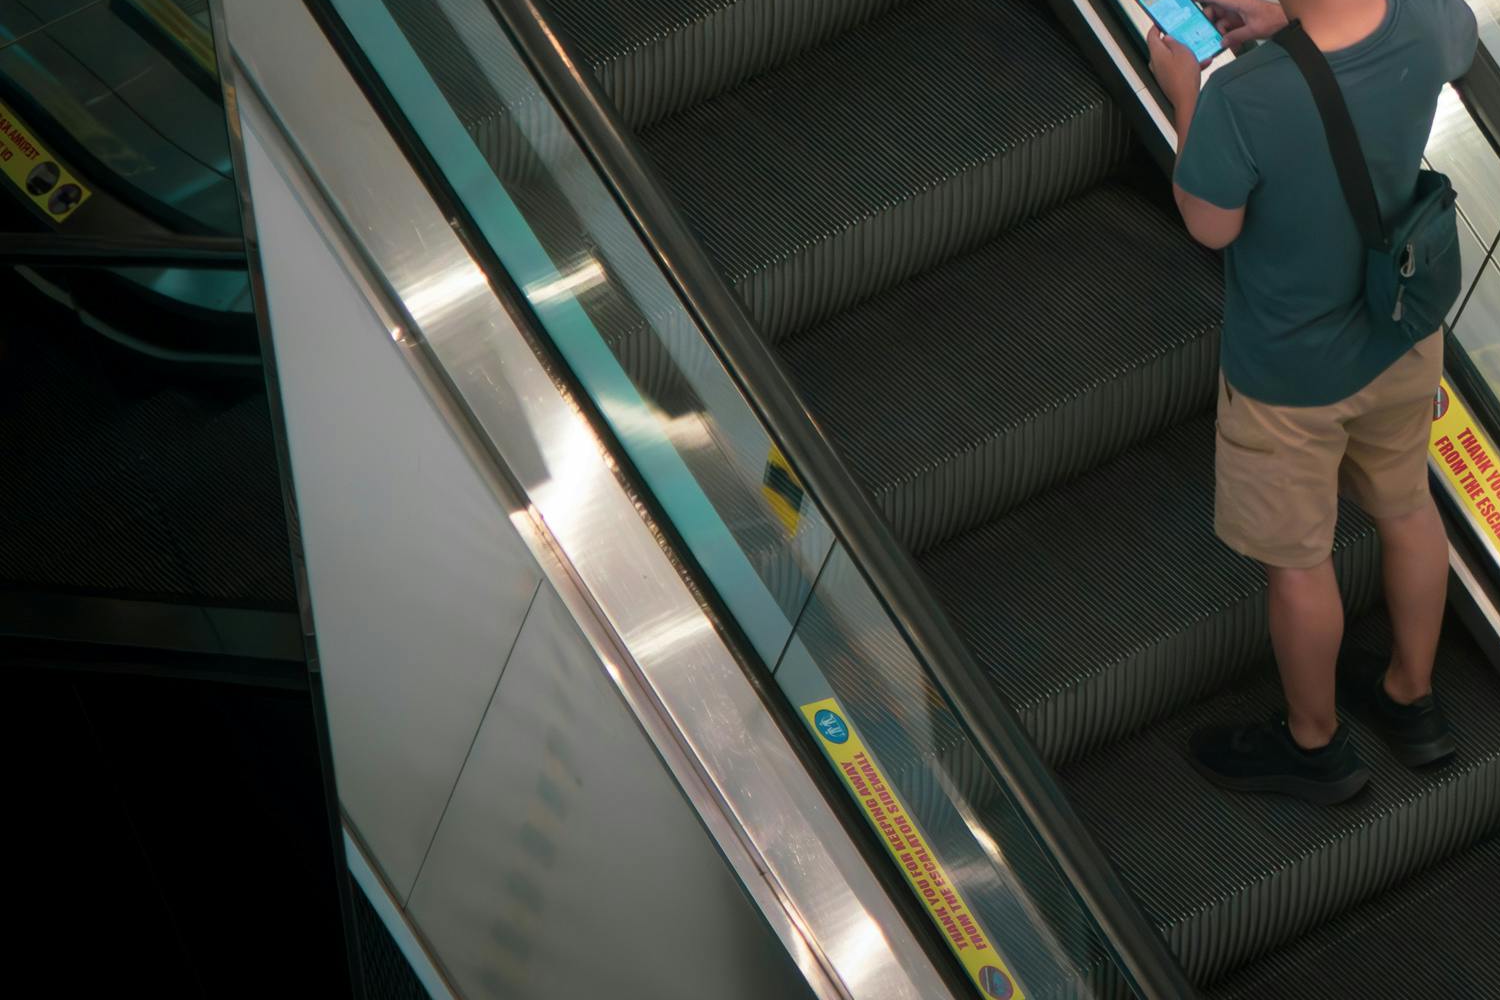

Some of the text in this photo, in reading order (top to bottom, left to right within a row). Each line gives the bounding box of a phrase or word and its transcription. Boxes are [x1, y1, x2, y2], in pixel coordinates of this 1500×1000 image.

[1434, 436, 1467, 475] FROM
[1459, 472, 1485, 500] THE
[1456, 427, 1493, 474] THANK
[841, 761, 968, 950] THANK YOU FOR KEEPING AWAY
[853, 752, 987, 950] FROM THE ESCALATOR SIDEWALL
